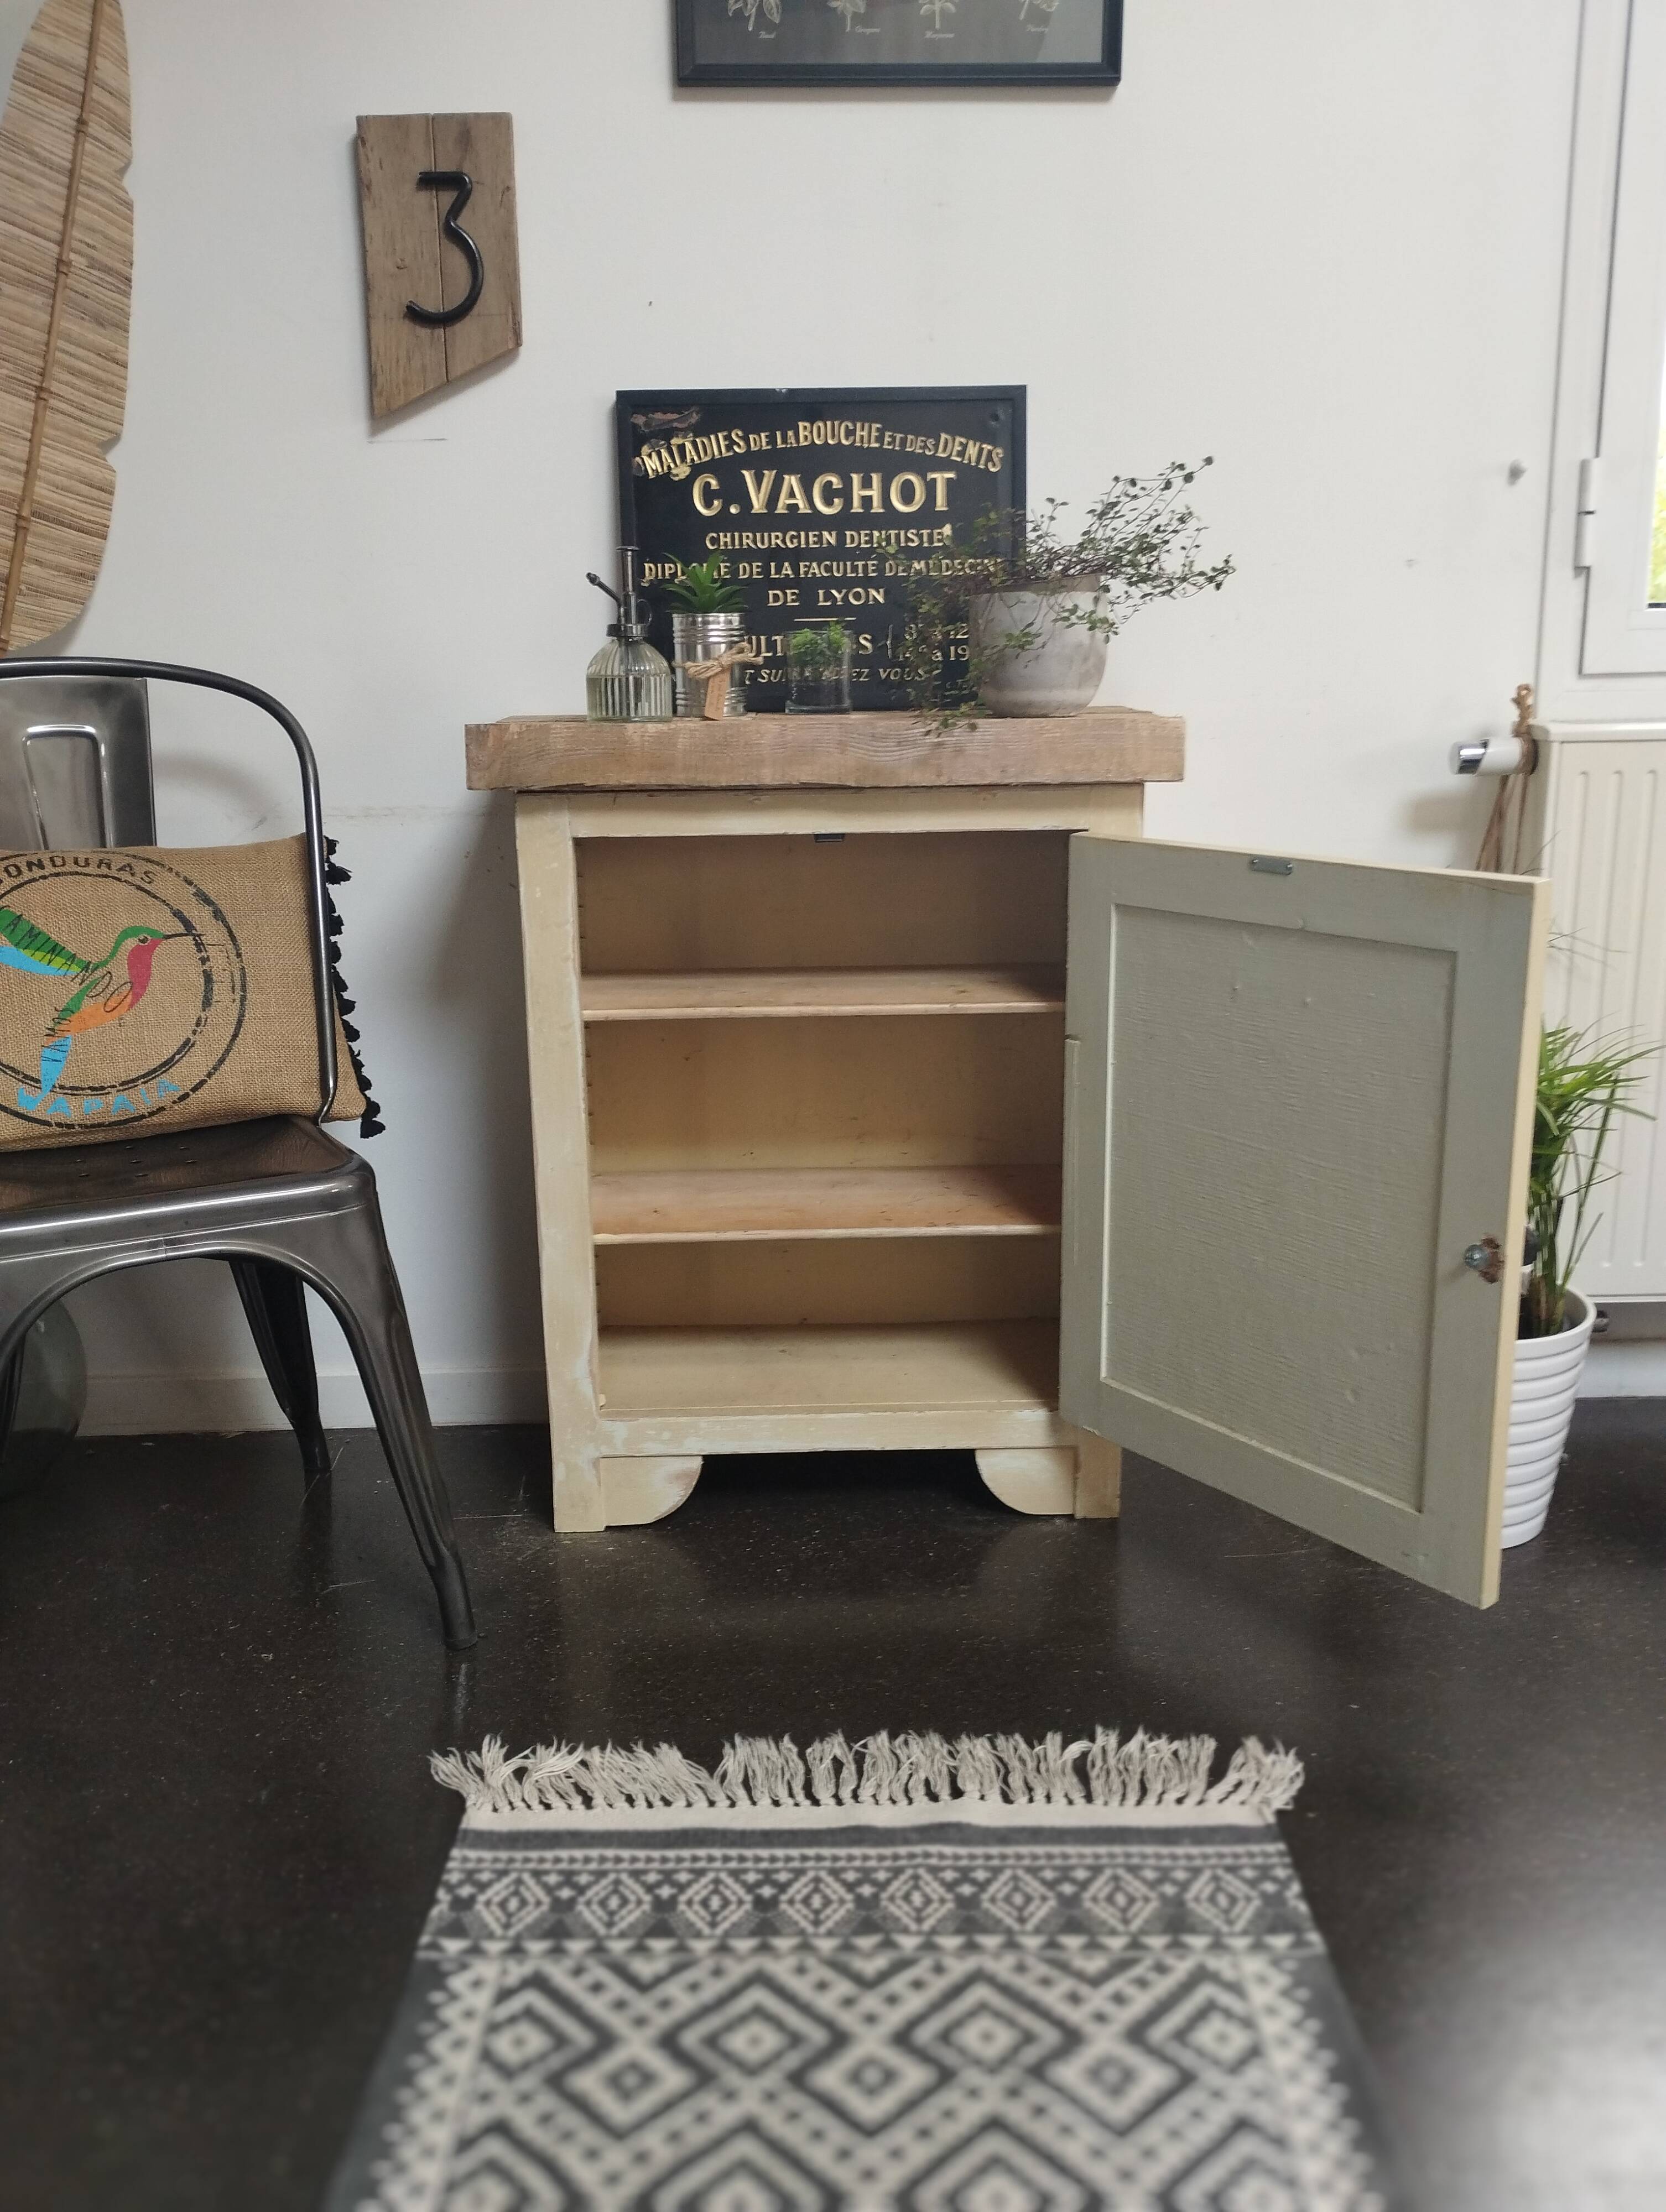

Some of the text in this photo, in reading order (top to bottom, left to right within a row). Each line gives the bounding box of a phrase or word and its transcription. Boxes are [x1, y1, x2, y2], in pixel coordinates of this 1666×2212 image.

[405, 171, 483, 327] 3
[642, 420, 1004, 479] MALADIES DE LA BOUCHE ET DES DENTS
[705, 529, 945, 549] CHIRURGIEN DENTISTE
[738, 562, 764, 578] DE
[769, 561, 795, 578] LA
[799, 554, 878, 578] FACULTÉ
[766, 588, 885, 606] DE LYON
[0, 855, 158, 884] ONDURAS
